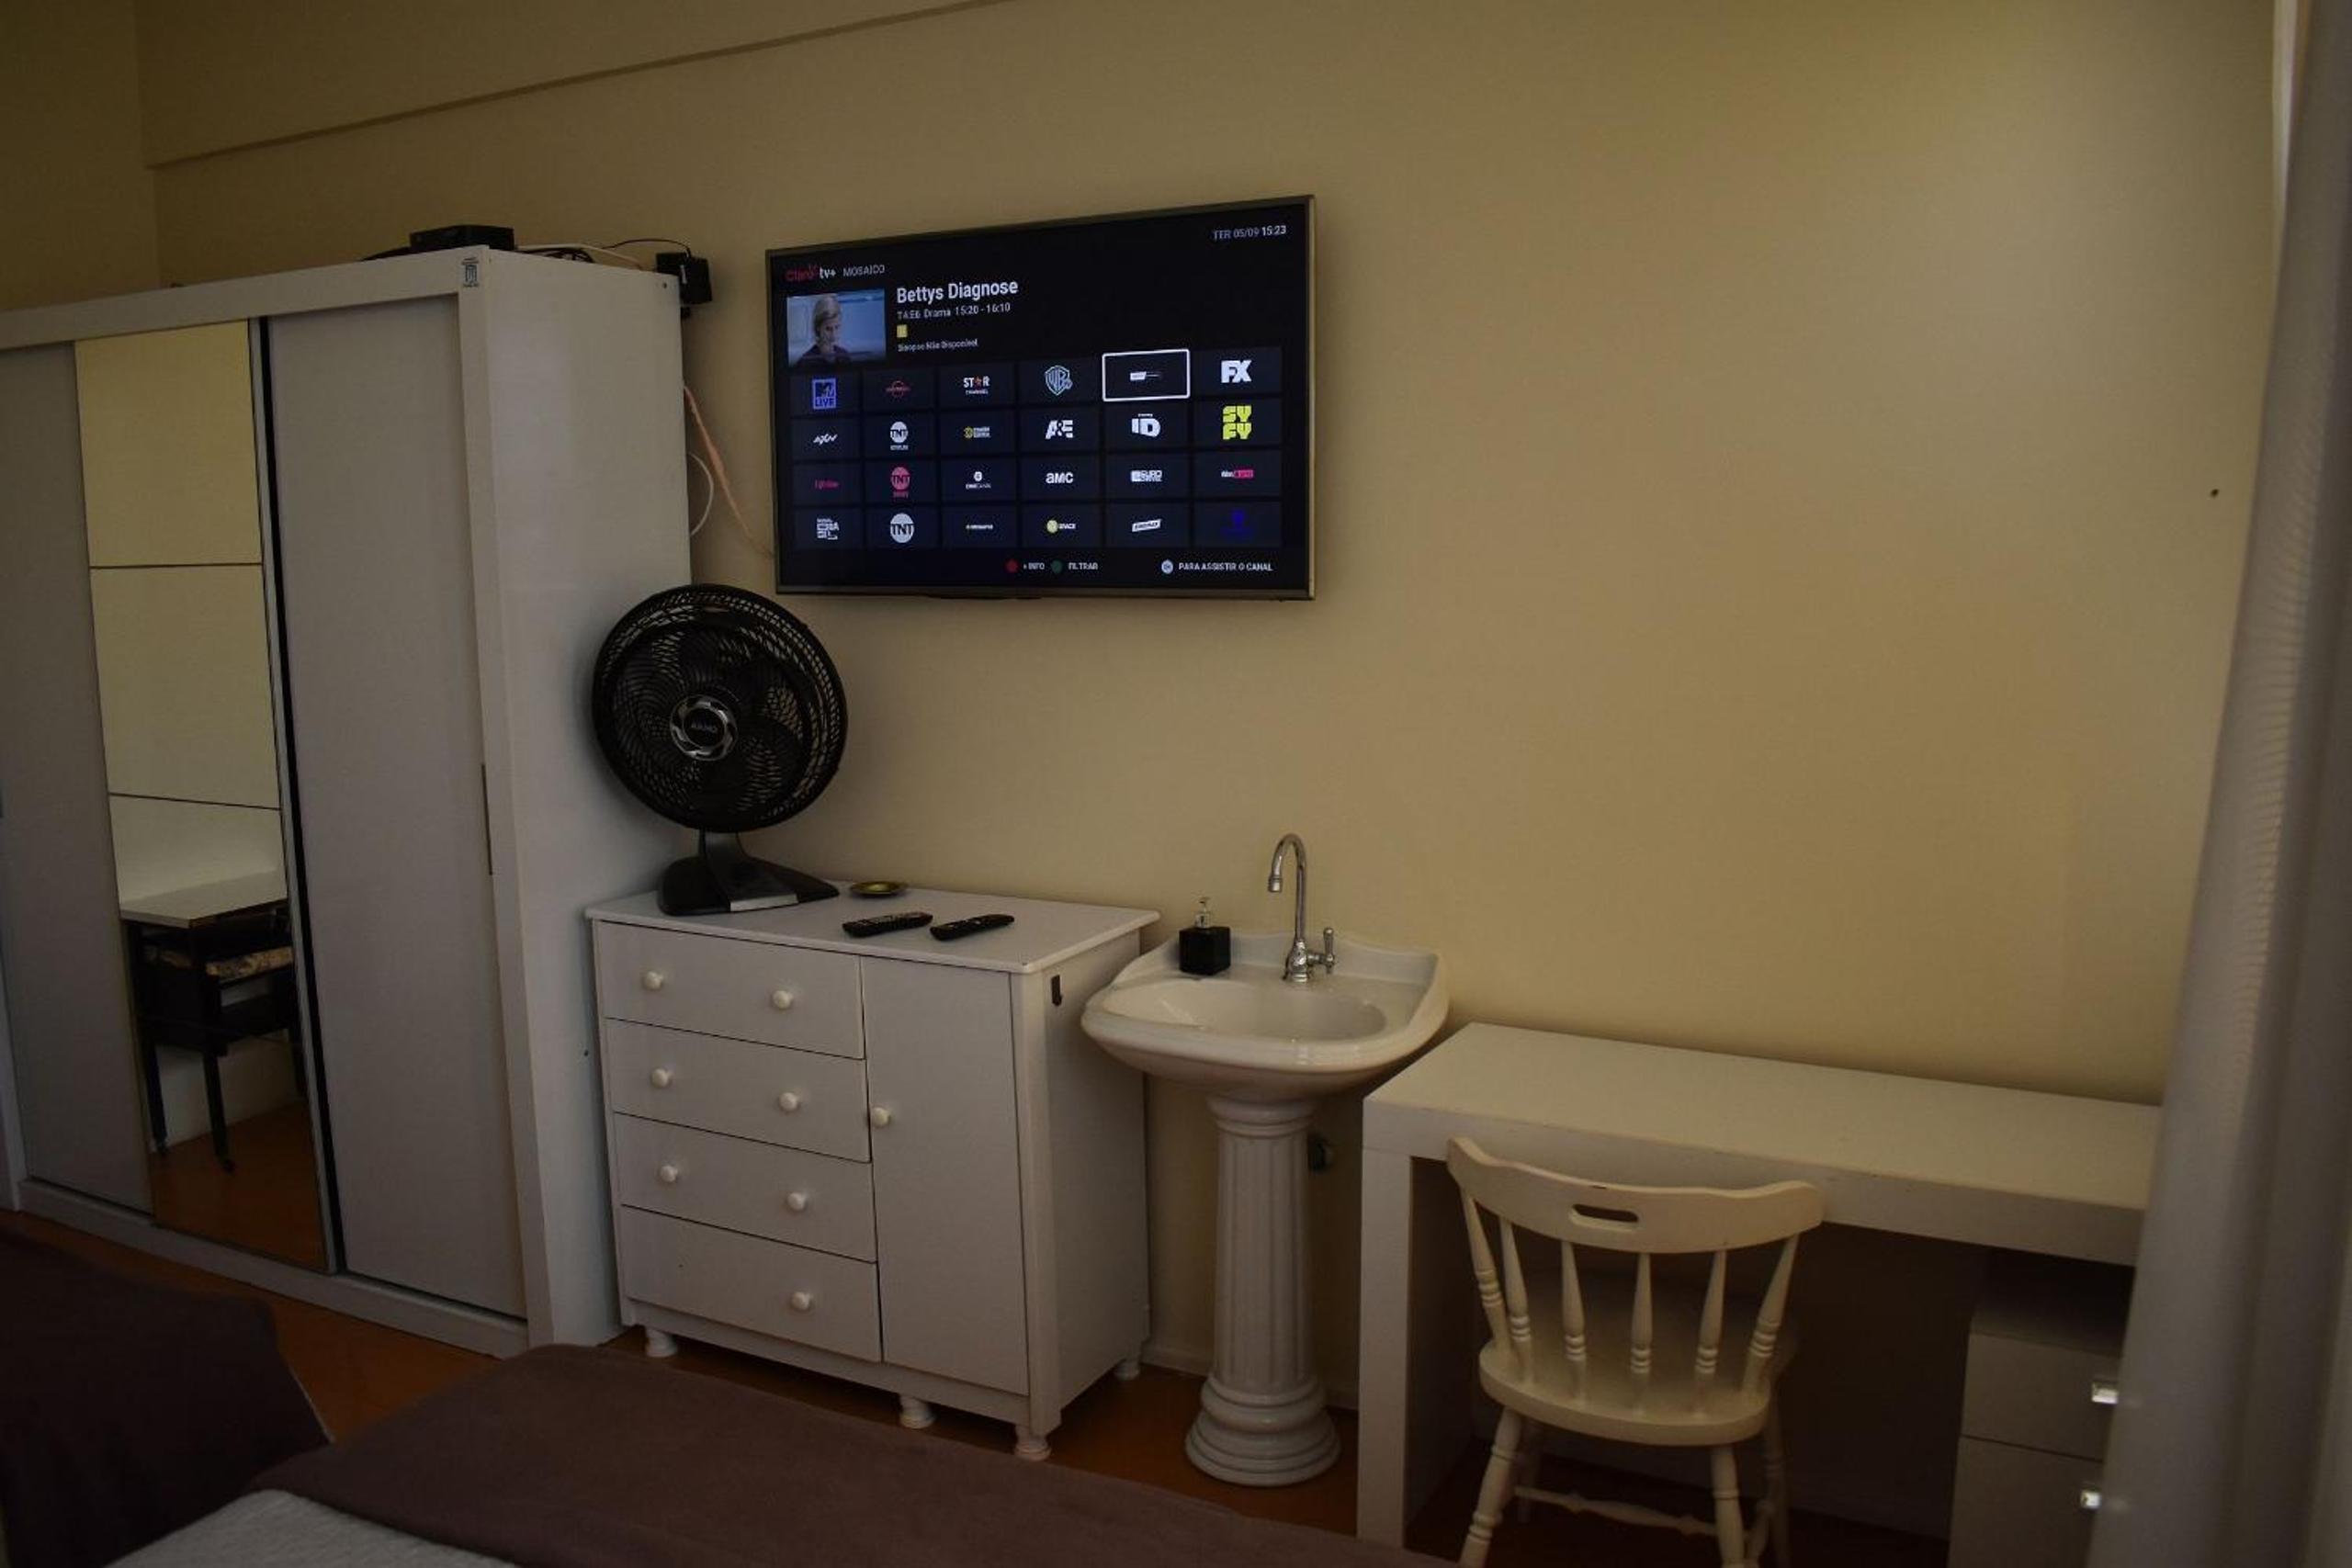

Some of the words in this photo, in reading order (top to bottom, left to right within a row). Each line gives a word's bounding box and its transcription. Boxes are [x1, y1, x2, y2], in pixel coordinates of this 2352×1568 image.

[897, 287, 944, 305] Bettys
[947, 281, 1019, 301] Diagnose
[1220, 359, 1252, 384] FX
[1131, 418, 1161, 438] ID
